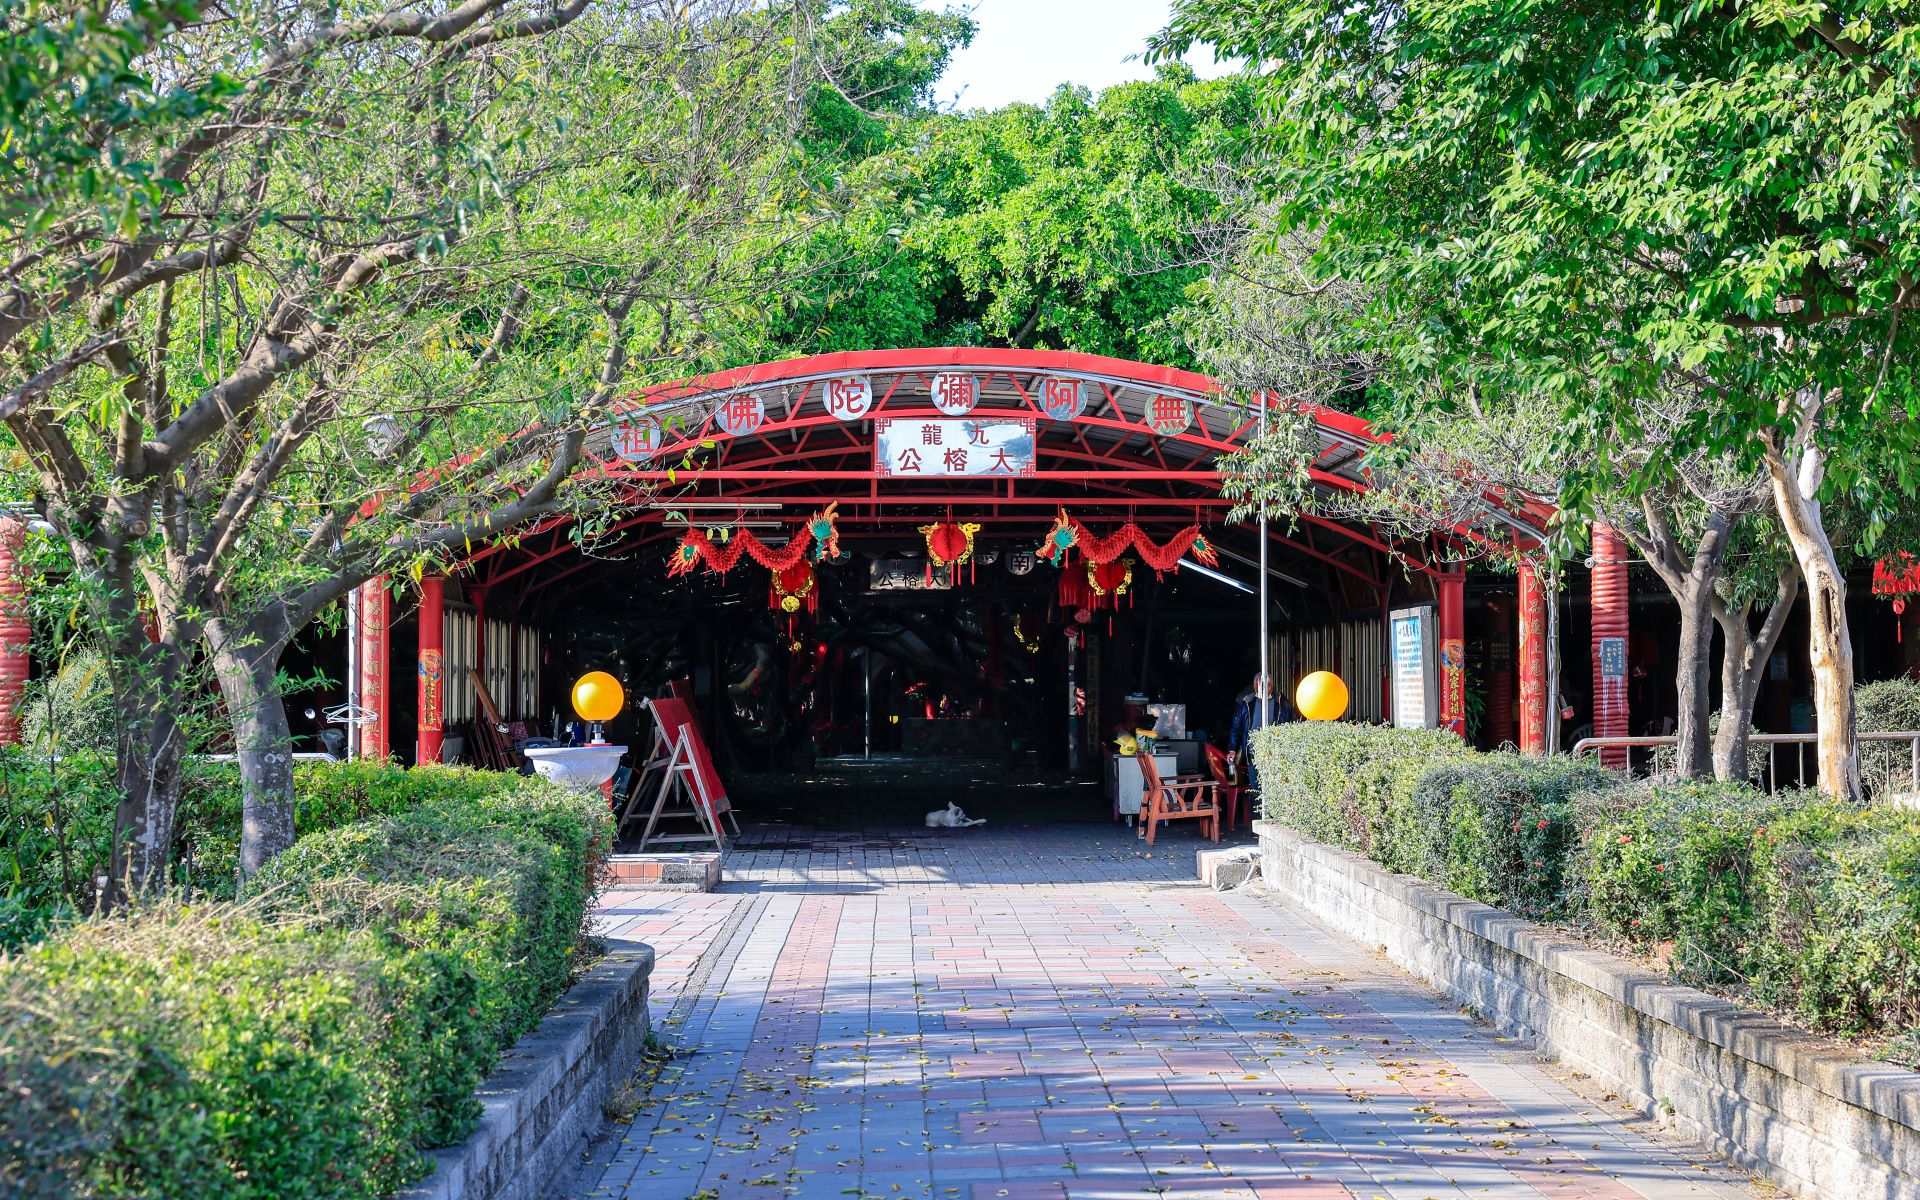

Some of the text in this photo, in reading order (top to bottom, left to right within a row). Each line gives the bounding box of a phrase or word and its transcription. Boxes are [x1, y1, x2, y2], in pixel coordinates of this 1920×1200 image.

[921, 424, 990, 446] 九龍
[898, 447, 1014, 474] 大榕公
